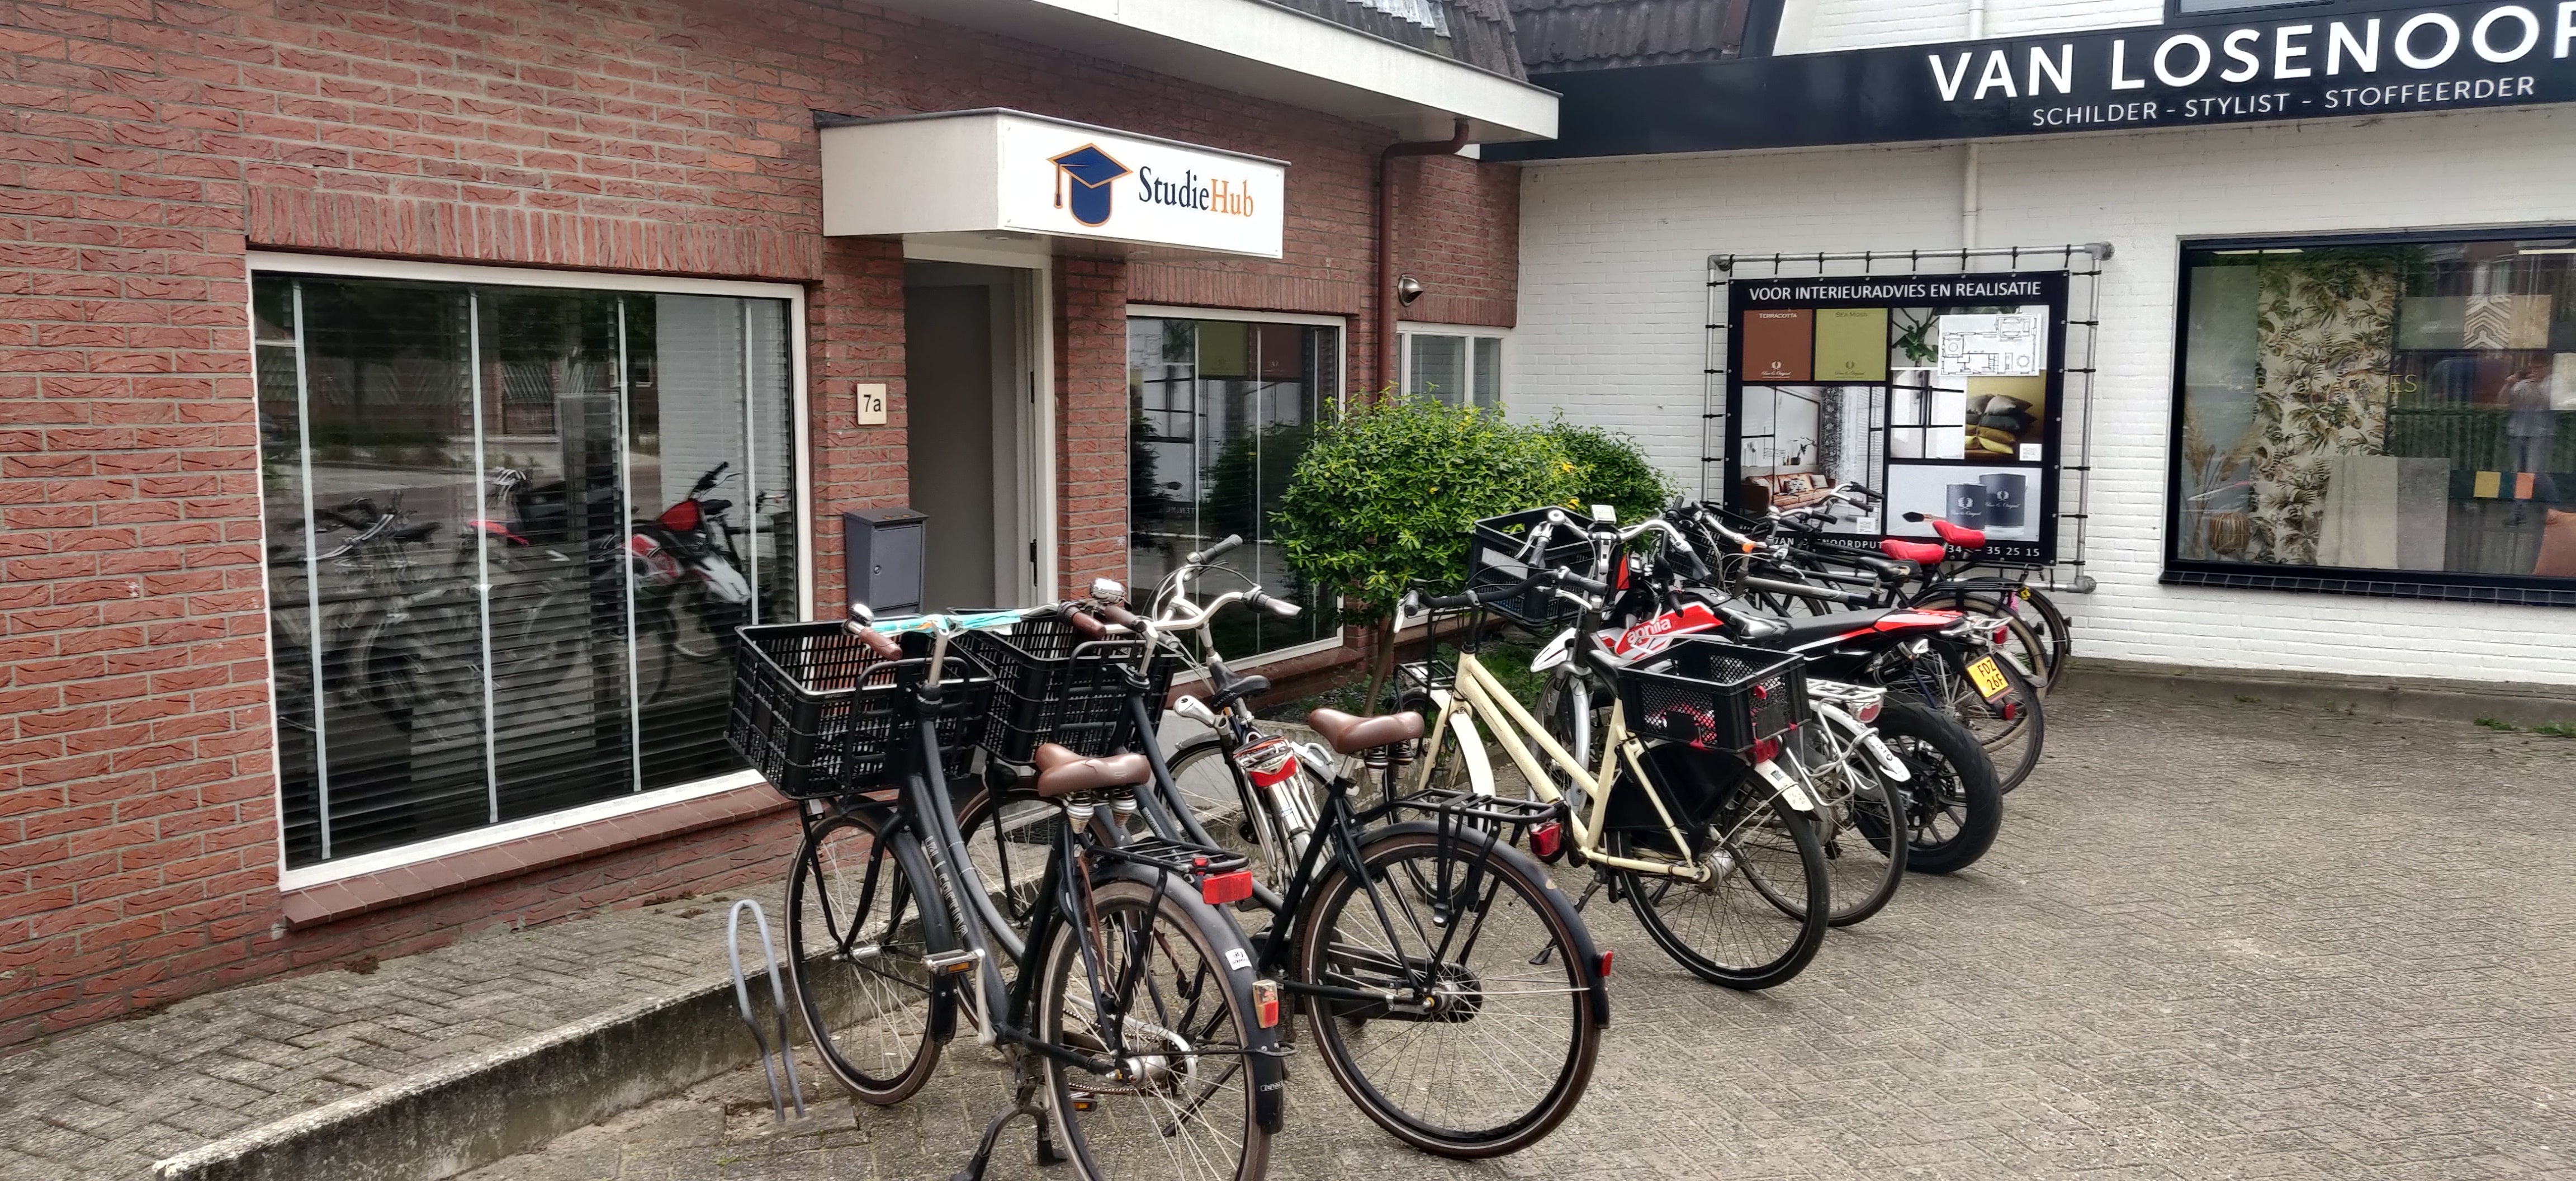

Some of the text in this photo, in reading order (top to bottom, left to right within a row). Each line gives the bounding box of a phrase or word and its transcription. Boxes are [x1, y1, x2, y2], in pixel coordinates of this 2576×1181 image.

[1929, 44, 2073, 101] VAN
[2033, 102, 2157, 126] SCHILDER
[2185, 93, 2290, 117] STYLIST
[2324, 77, 2535, 108] STOFFEERDER
[1139, 166, 1254, 217] StudieHub
[1749, 282, 2042, 300] VOOR INTERIEURADVIES EN REALISATIE
[863, 394, 881, 412] 7a
[1986, 546, 2001, 555] 35
[2006, 546, 2020, 556] 25
[2025, 547, 2040, 557] 15
[1977, 659, 1996, 678] FDZ
[1986, 673, 2004, 691] 26F
